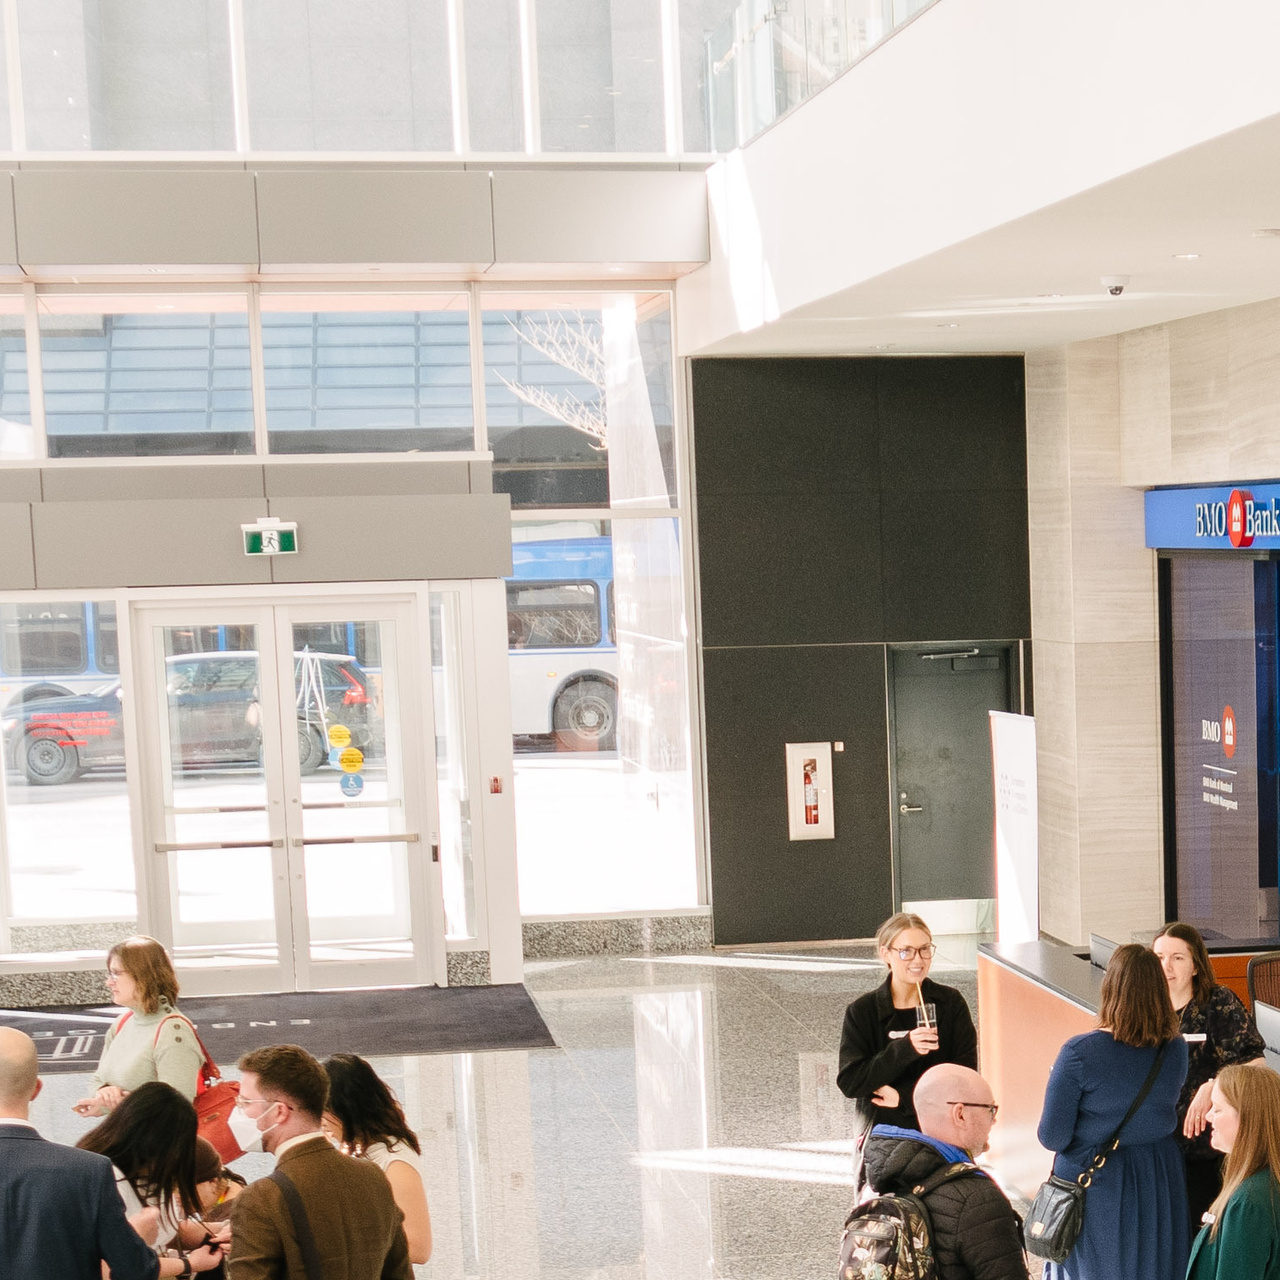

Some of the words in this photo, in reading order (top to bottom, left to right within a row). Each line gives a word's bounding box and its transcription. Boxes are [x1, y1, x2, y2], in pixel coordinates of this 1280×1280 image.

[1195, 502, 1227, 537] BMO
[1244, 497, 1280, 537] Bank
[1202, 719, 1221, 742] BMO
